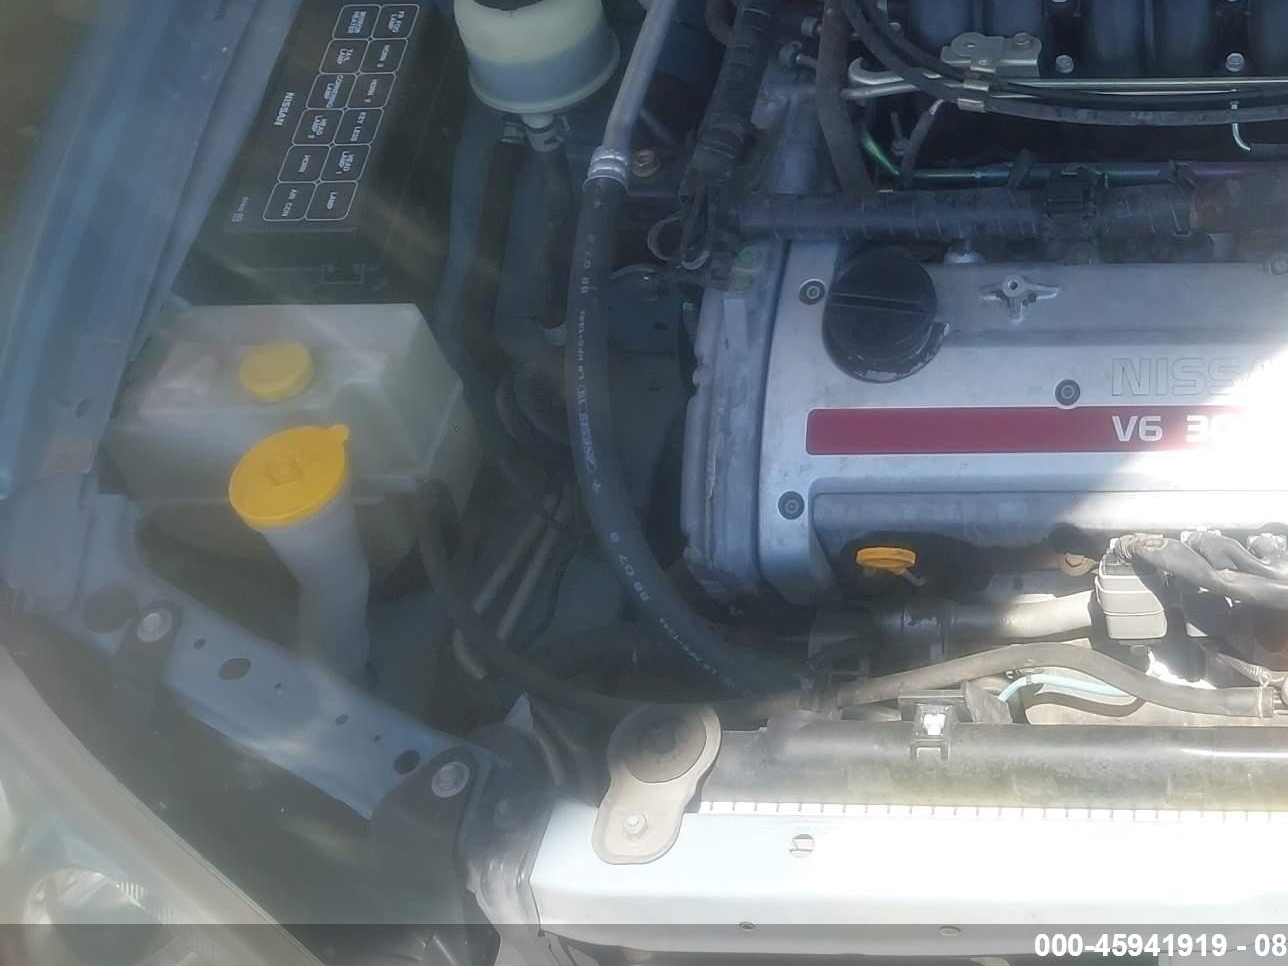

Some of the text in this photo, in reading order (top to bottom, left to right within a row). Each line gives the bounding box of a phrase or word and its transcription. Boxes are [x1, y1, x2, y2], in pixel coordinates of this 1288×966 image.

[274, 92, 295, 126] NISSAN
[1111, 356, 1266, 397] NISS
[1112, 415, 1163, 442] V6
